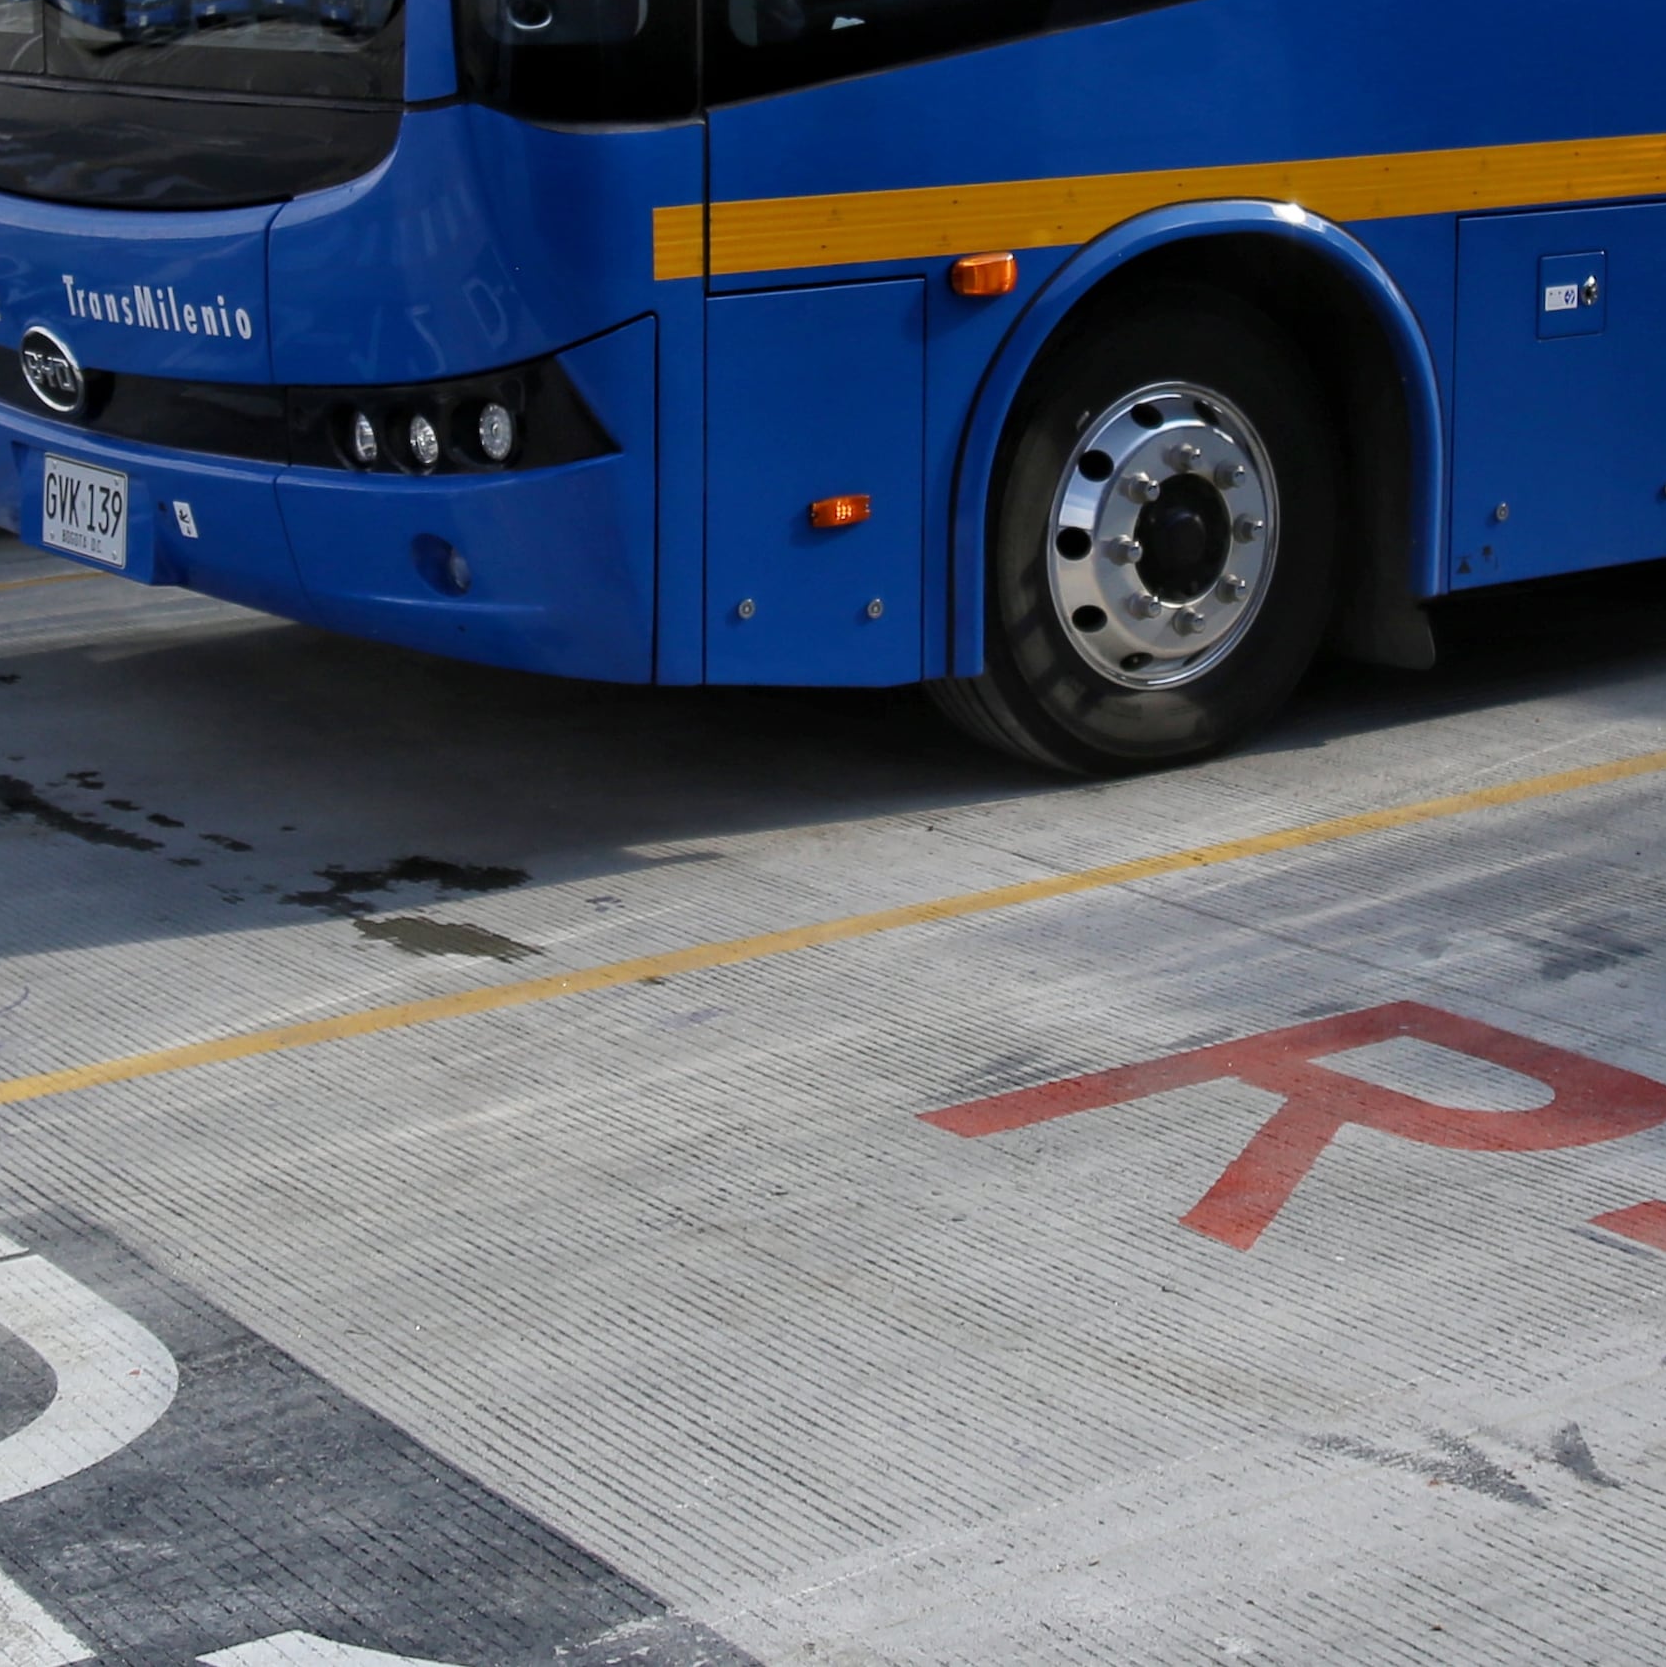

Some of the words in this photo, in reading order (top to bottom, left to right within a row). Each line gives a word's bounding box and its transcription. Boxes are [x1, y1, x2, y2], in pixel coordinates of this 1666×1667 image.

[62, 274, 253, 340] TransMilenio
[24, 351, 76, 392] BYD
[46, 472, 81, 528] GVK
[87, 484, 123, 538] 139
